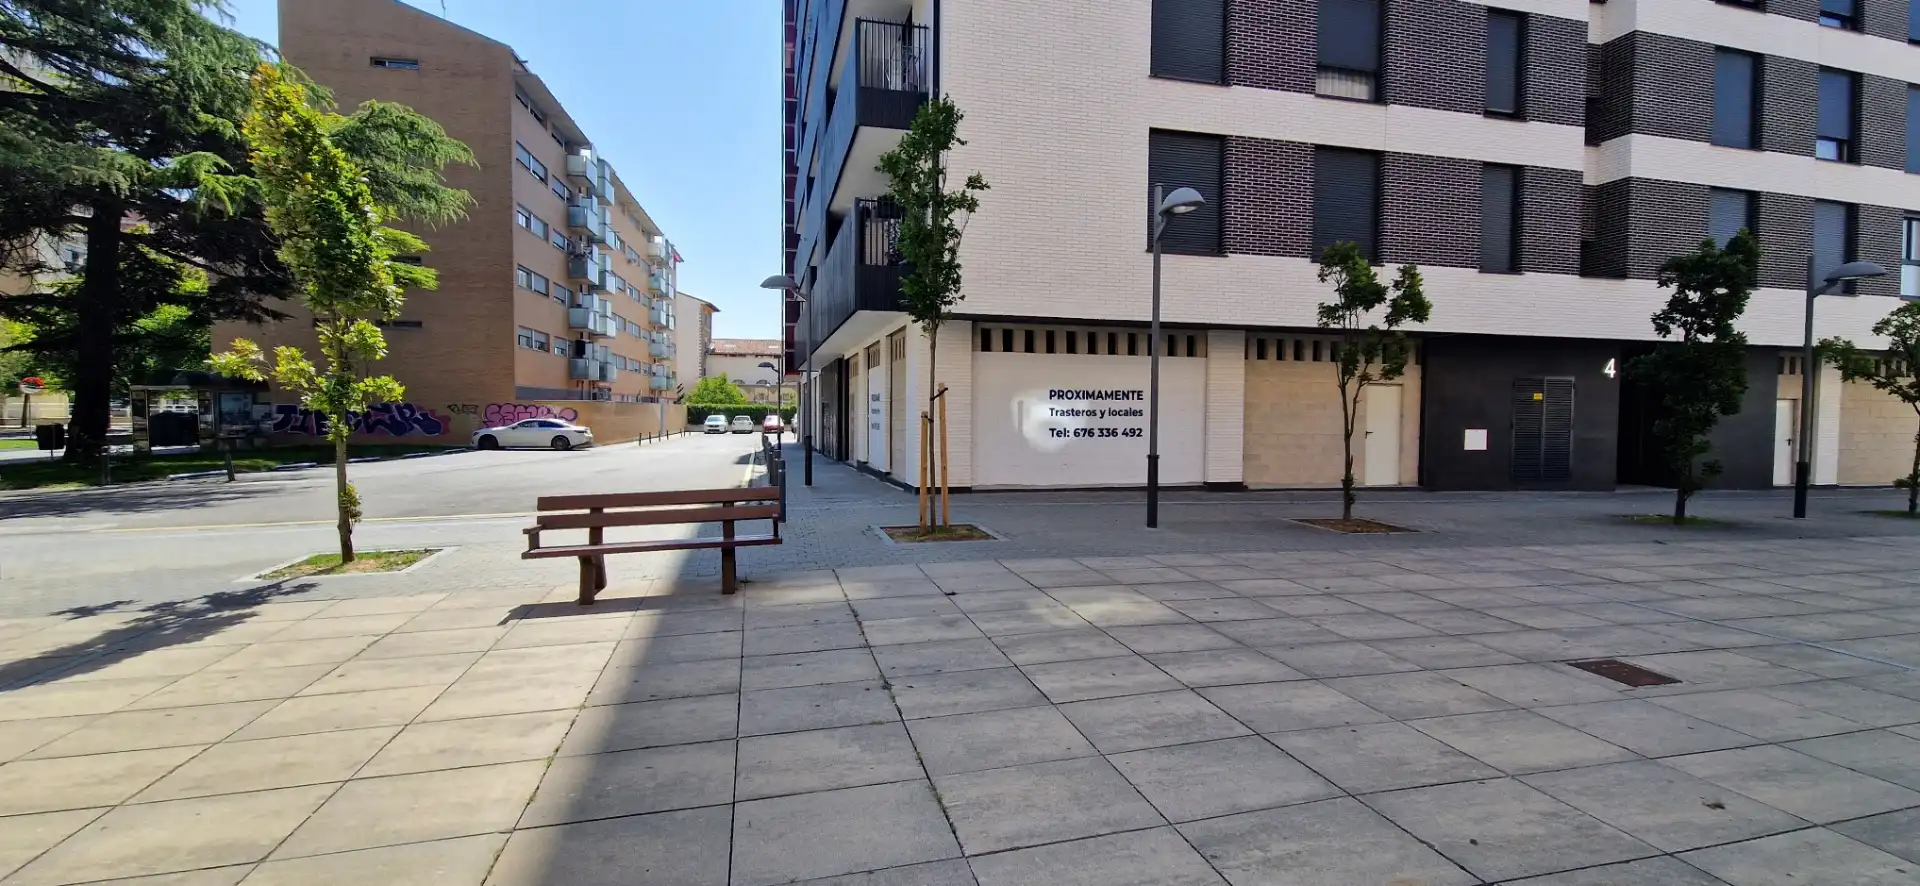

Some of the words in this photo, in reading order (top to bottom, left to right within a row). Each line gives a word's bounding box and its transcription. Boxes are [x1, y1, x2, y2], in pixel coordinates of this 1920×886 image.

[1604, 357, 1616, 379] 4
[1049, 389, 1144, 401] PROXIMAMENTE
[1049, 407, 1097, 417] Trasteros
[1099, 409, 1107, 419] y
[1108, 407, 1144, 417] locales
[1049, 427, 1070, 438] Tel:
[1073, 428, 1095, 438] 676
[1097, 428, 1119, 438] 336
[1121, 428, 1143, 438] 492
